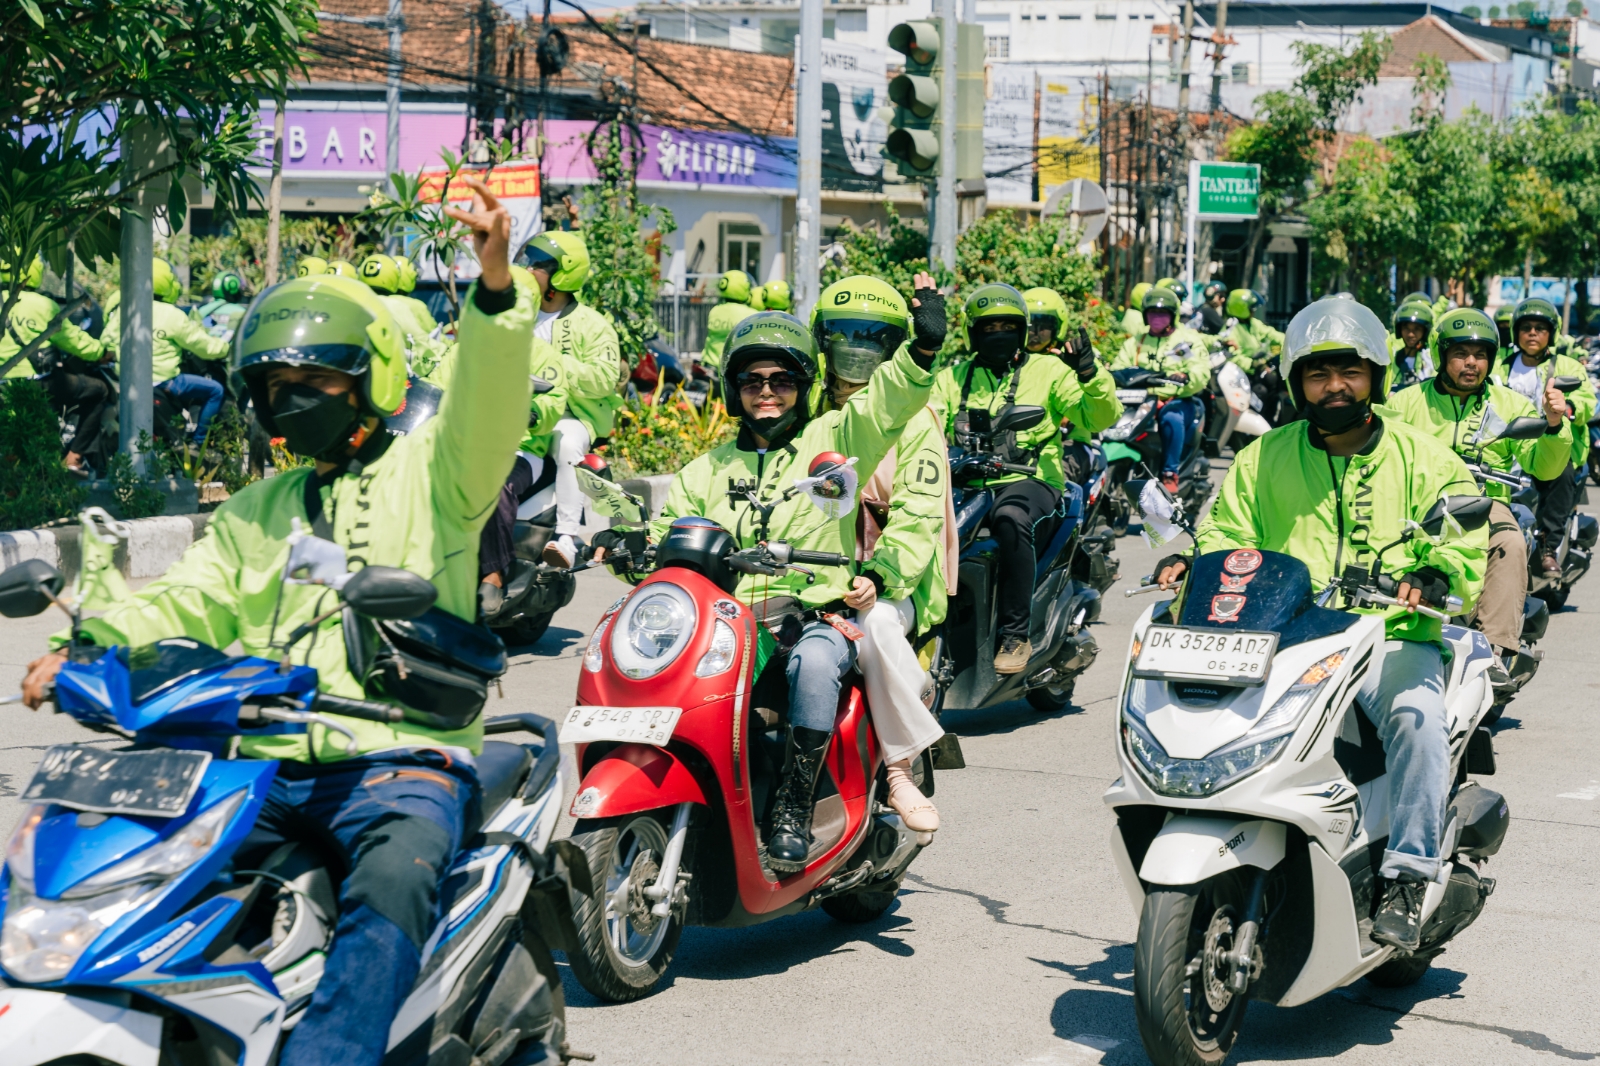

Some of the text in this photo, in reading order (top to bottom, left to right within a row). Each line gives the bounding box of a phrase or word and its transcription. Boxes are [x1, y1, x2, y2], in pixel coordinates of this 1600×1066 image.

[820, 52, 858, 72] ANTERI
[854, 291, 899, 312] inDrive
[990, 296, 1020, 306] inDrive
[261, 306, 331, 326] inDrive
[1466, 319, 1494, 332] inDrive
[557, 318, 572, 357] rive
[755, 322, 802, 338] inDrive
[1150, 631, 1270, 655] DK 3528 ADZ
[1183, 687, 1218, 696] HONDA
[568, 709, 674, 724] B 4548 SRJ
[1327, 818, 1349, 835] 160
[1218, 831, 1246, 858] SPORT
[136, 920, 197, 964] HONDA
